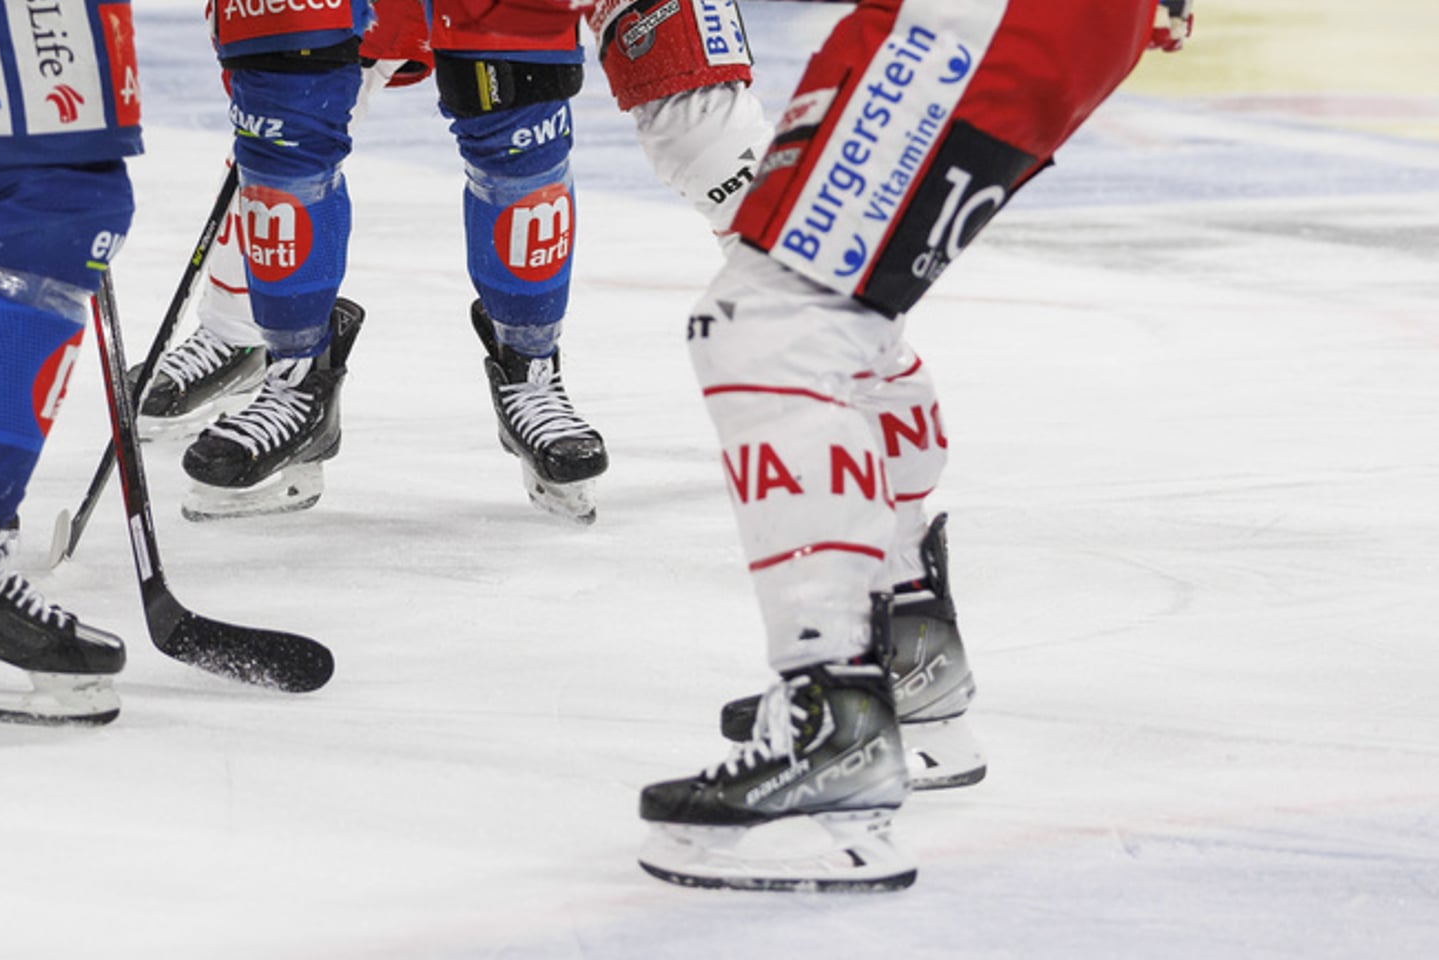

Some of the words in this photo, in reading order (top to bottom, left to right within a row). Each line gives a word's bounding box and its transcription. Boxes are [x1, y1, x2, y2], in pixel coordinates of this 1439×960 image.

[706, 166, 755, 205] OBT
[782, 24, 938, 262] Burgerstein
[863, 102, 948, 224] Vitamine
